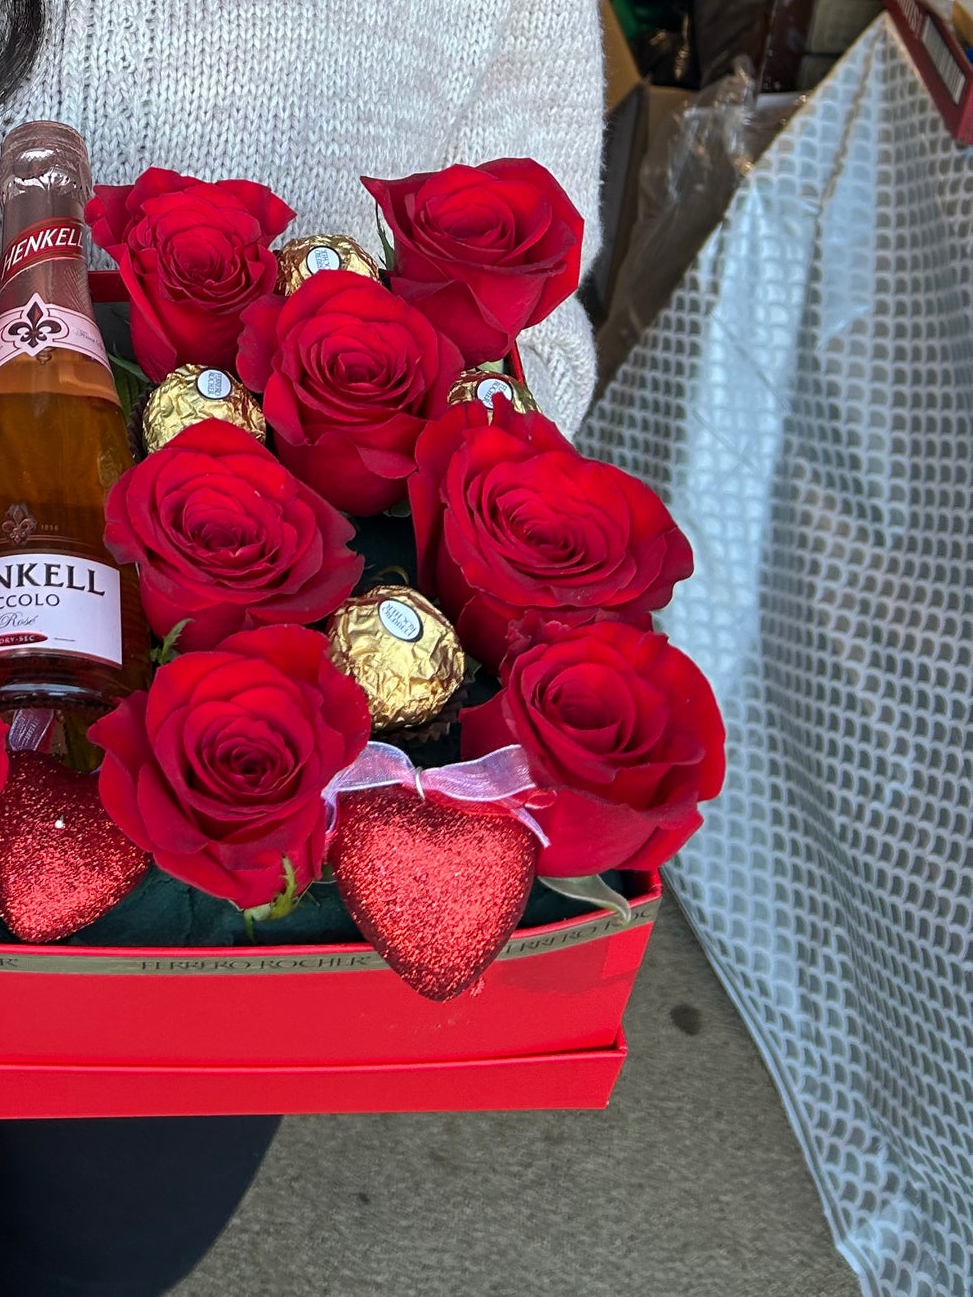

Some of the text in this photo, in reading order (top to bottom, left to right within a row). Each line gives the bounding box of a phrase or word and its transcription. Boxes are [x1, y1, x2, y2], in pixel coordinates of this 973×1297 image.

[1, 227, 84, 280] HENKELL
[506, 927, 598, 954] ERRERO
[141, 955, 370, 970] FERRERO ROCHER
